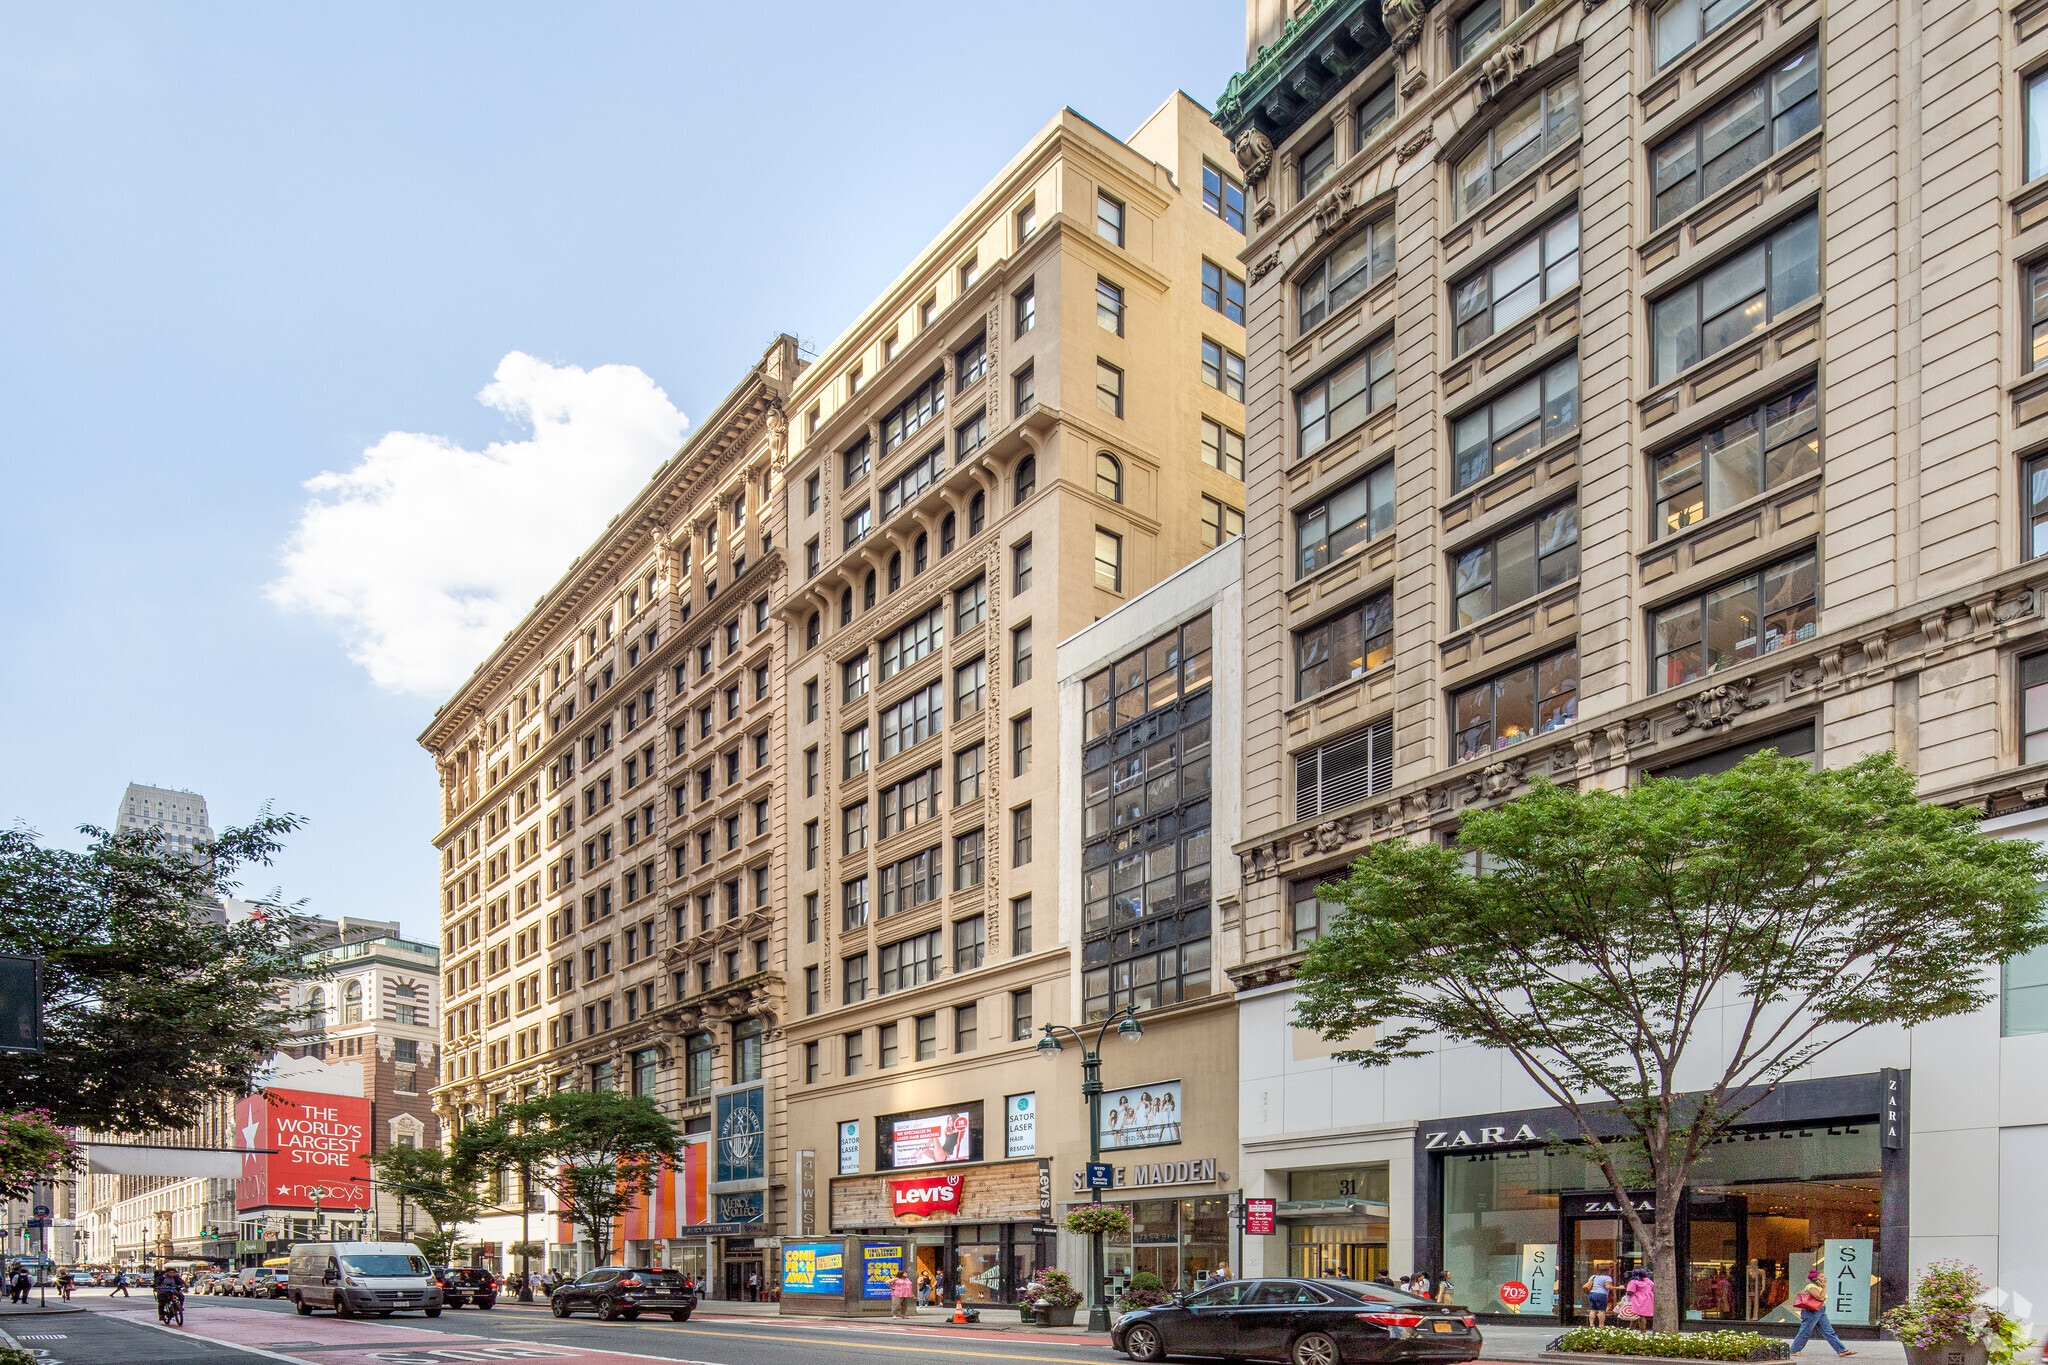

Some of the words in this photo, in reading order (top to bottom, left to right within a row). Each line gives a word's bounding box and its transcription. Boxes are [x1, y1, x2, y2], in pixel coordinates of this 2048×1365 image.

[301, 1105, 338, 1121] THE
[1888, 1079, 1897, 1137] ZARA
[277, 1118, 362, 1138] WORLD'S
[1009, 1123, 1033, 1132] LASER
[277, 1133, 360, 1152] LARGEST
[1425, 1124, 1541, 1149] ZARA
[291, 1150, 349, 1167] STORE
[1134, 1158, 1216, 1185] MADDEN
[1339, 1179, 1358, 1196] 31
[720, 1197, 749, 1214] MERCY
[721, 1207, 759, 1221] COLLEGE
[785, 1250, 815, 1261] COME
[785, 1272, 815, 1283] AWAY
[1530, 1250, 1545, 1304] SALE
[1836, 1247, 1856, 1312] SALE
[1503, 1286, 1527, 1298] 70%
